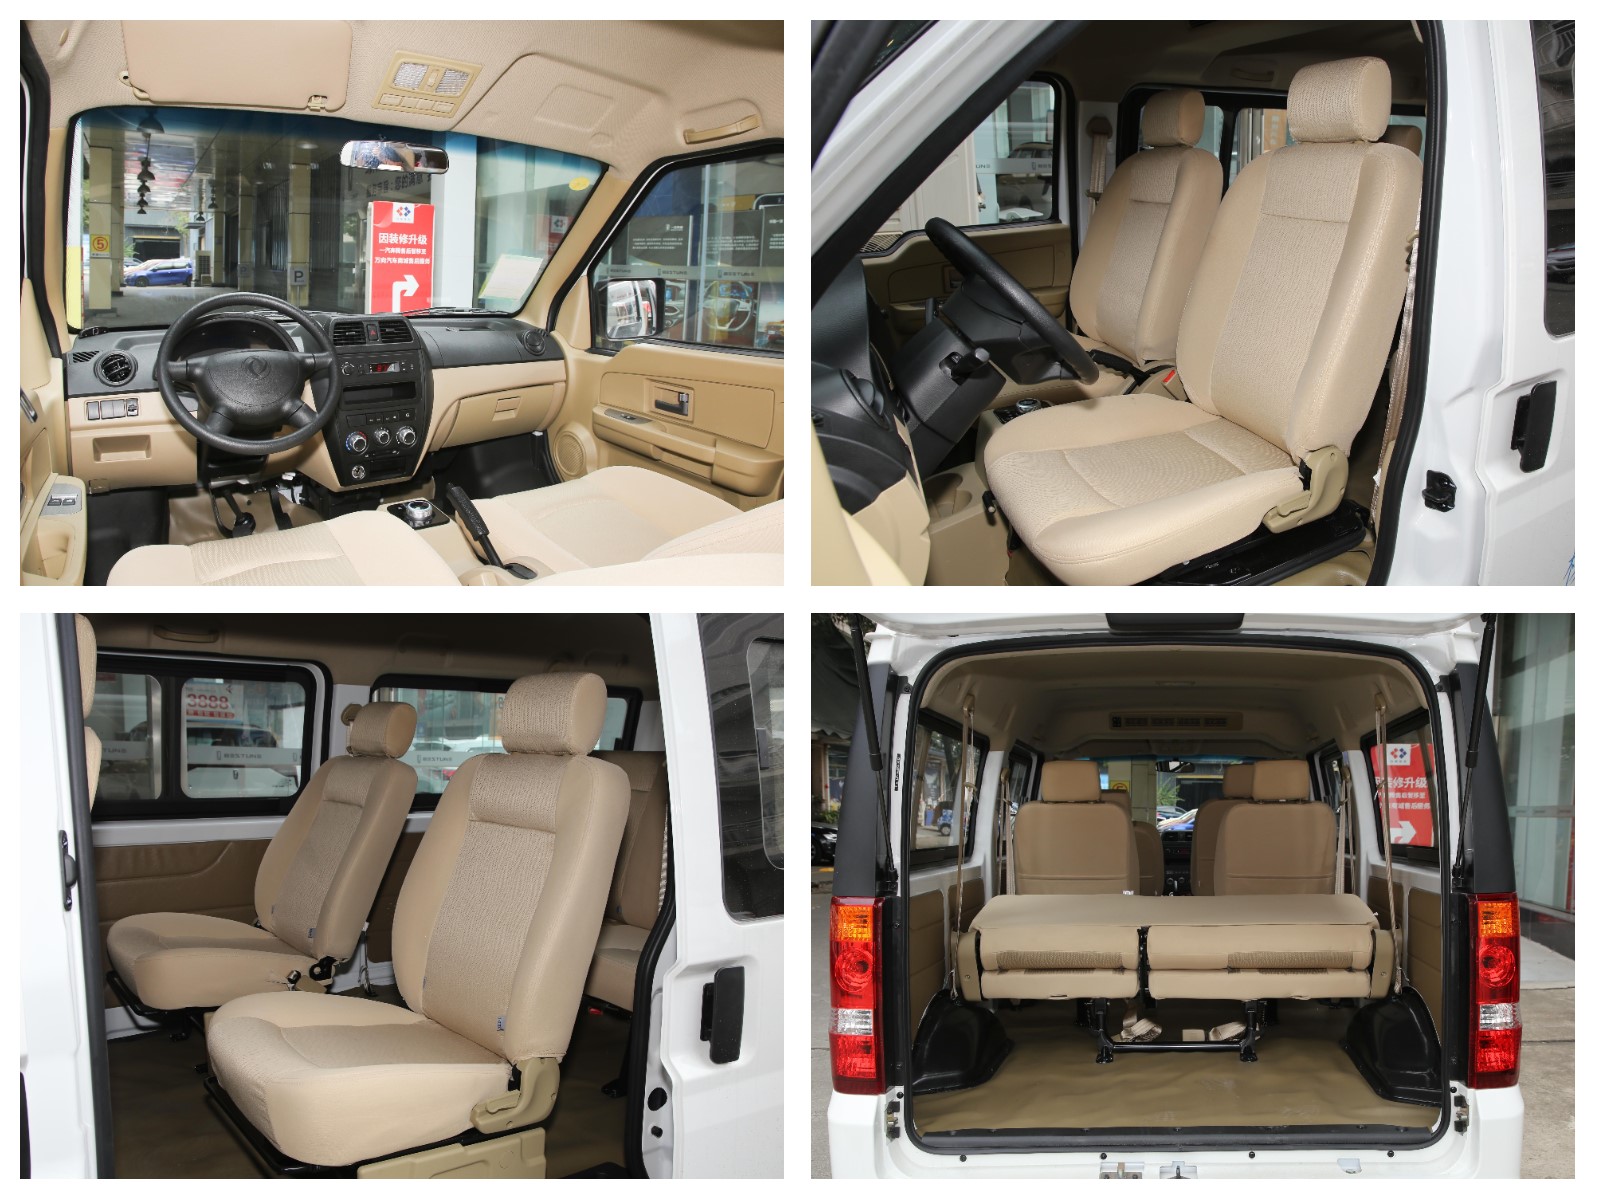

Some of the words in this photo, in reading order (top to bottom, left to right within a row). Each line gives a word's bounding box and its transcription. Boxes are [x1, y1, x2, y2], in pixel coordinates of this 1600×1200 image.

[96, 239, 105, 249] 5
[378, 232, 427, 245] 因装修升级
[294, 270, 304, 283] P
[186, 693, 230, 710] 3888
